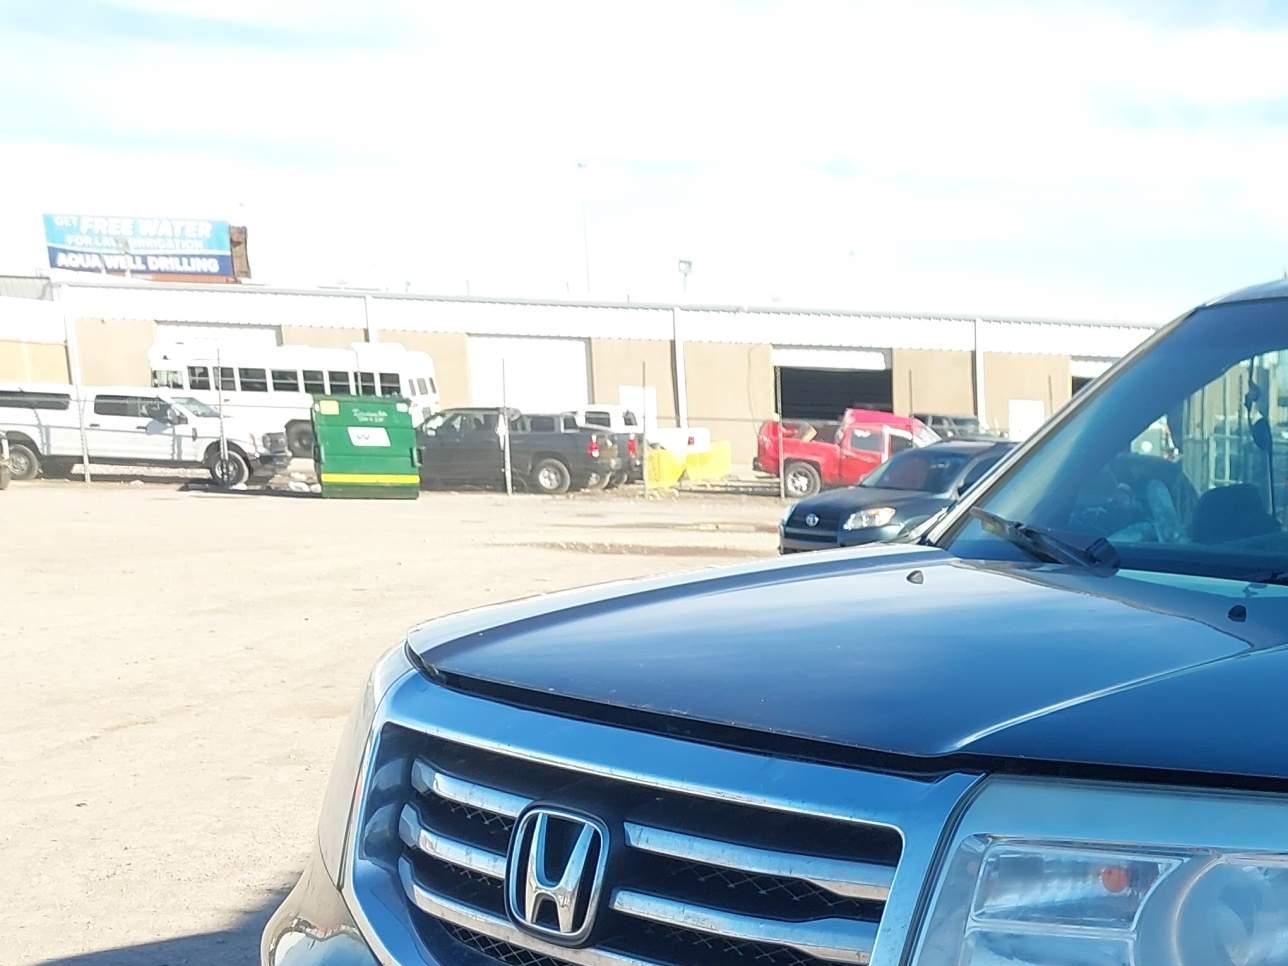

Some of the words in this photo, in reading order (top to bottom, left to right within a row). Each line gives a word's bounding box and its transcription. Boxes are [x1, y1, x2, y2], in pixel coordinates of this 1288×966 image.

[80, 217, 135, 237] FREE
[138, 218, 213, 240] WATER
[57, 252, 102, 269] AQUA
[104, 254, 148, 272] WELL
[148, 256, 220, 273] DRILLING
